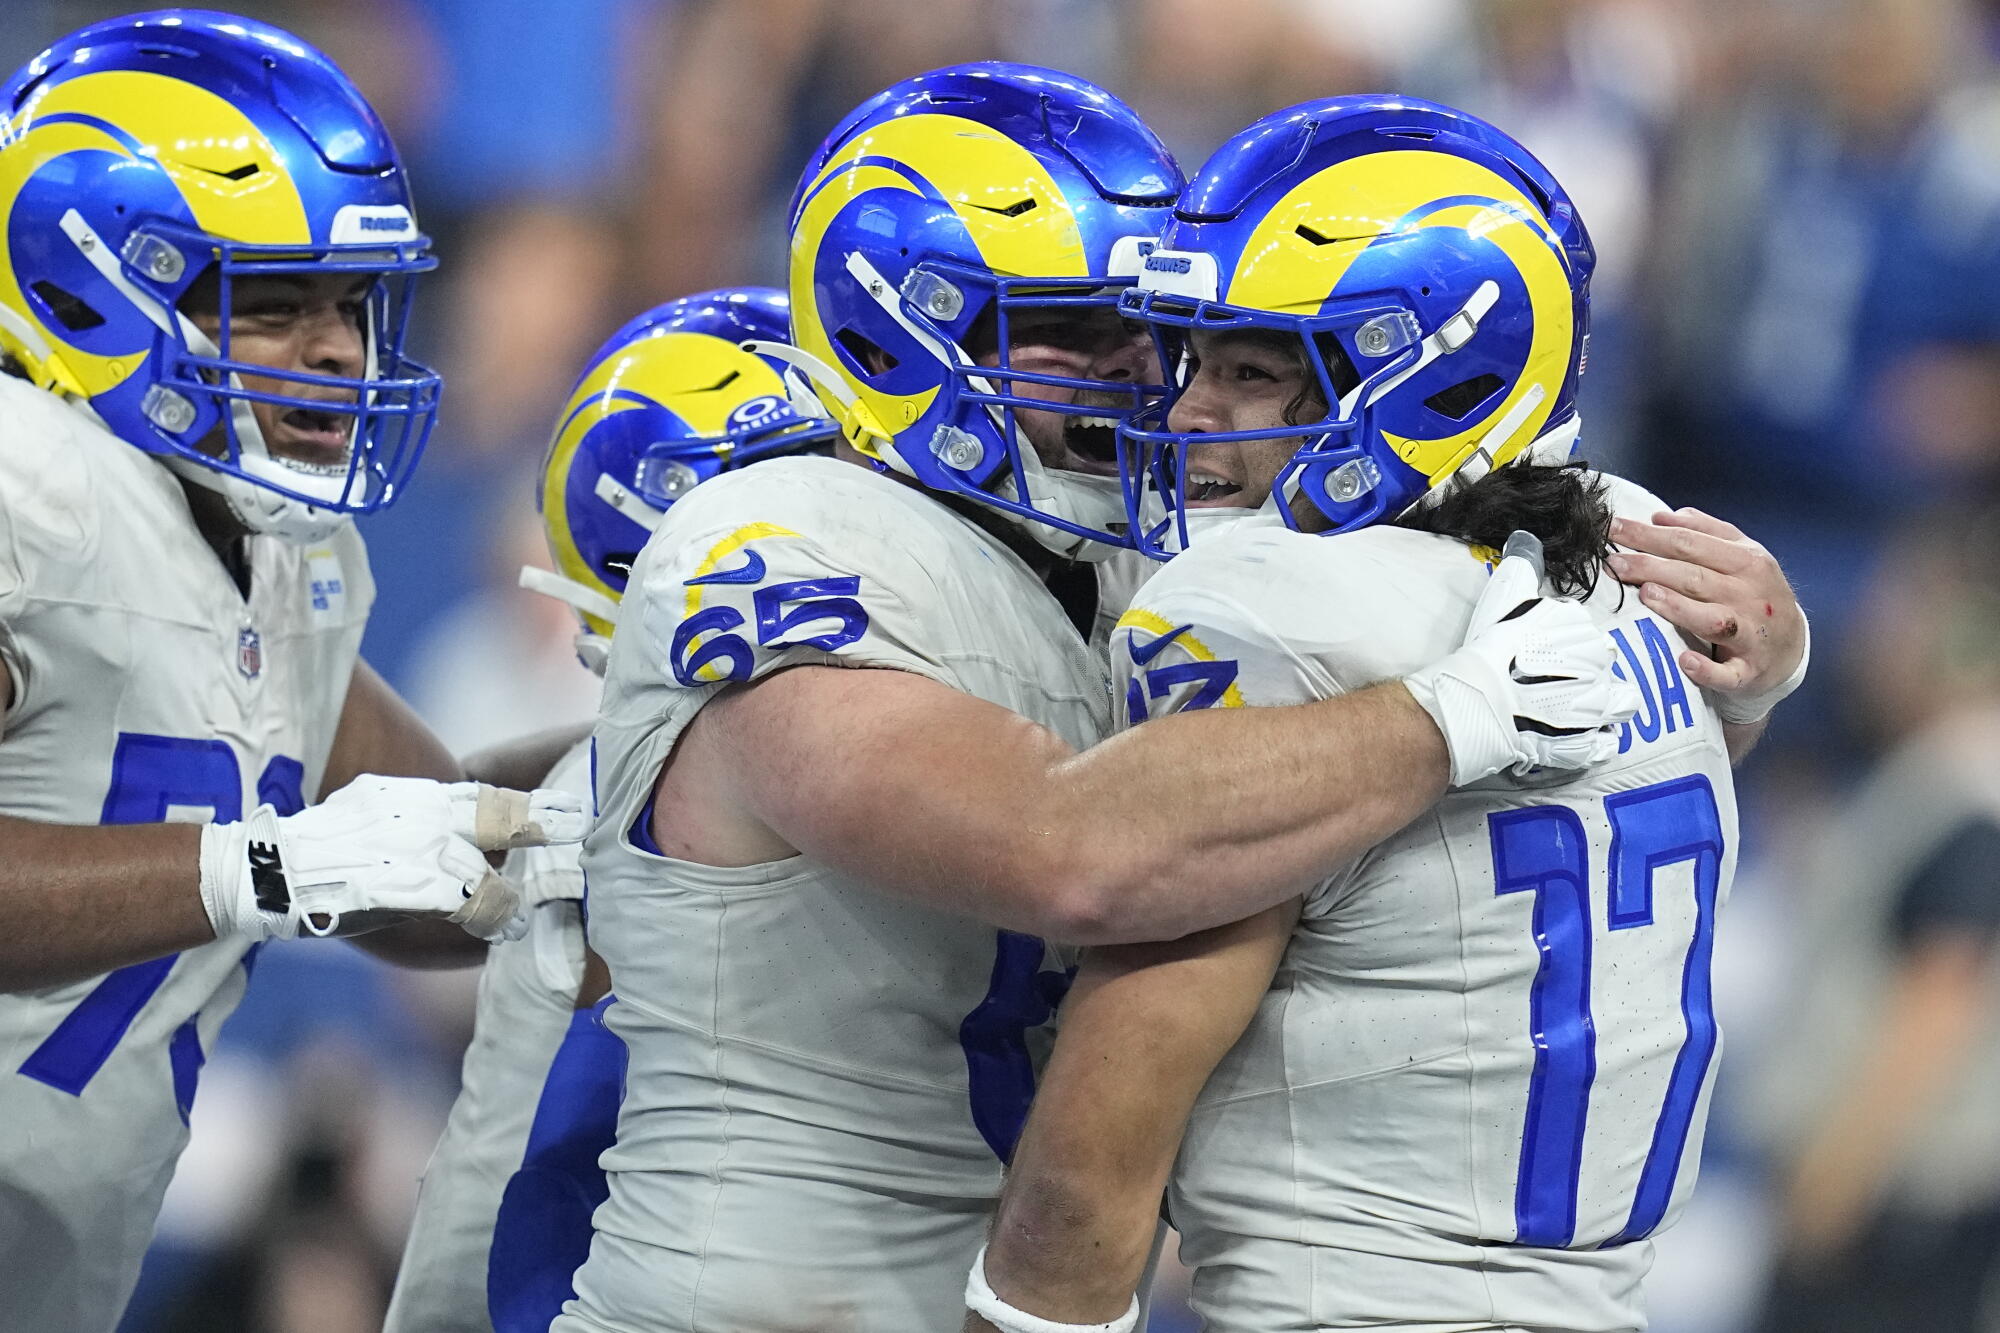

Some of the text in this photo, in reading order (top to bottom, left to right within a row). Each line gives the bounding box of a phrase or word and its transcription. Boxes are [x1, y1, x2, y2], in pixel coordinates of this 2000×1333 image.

[1144, 256, 1192, 274] RAMS
[670, 575, 869, 687] 65
[1487, 773, 1725, 1250] 17
